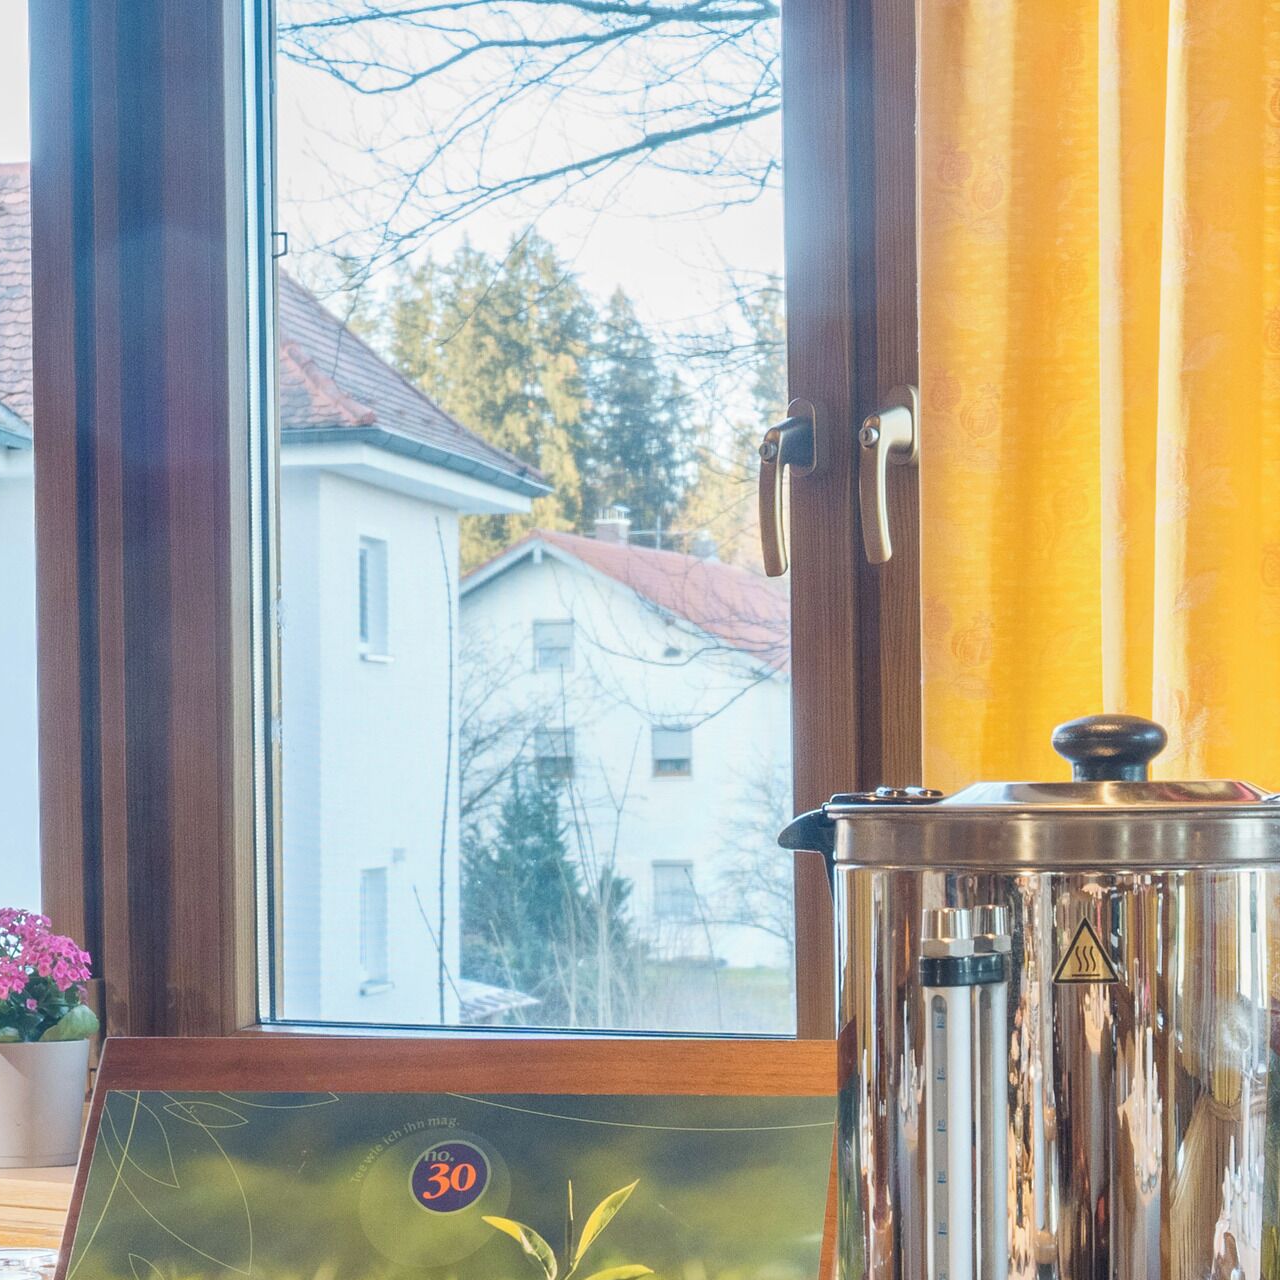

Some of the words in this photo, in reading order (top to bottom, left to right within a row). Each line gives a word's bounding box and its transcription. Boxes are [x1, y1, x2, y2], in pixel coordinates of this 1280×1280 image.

[351, 1164, 368, 1182] Tee
[364, 1143, 384, 1163] wie
[383, 1130, 402, 1145] ich
[403, 1119, 425, 1134] ihn
[428, 1117, 460, 1129] mag.
[424, 1151, 455, 1162] no.
[423, 1163, 477, 1200] 30
